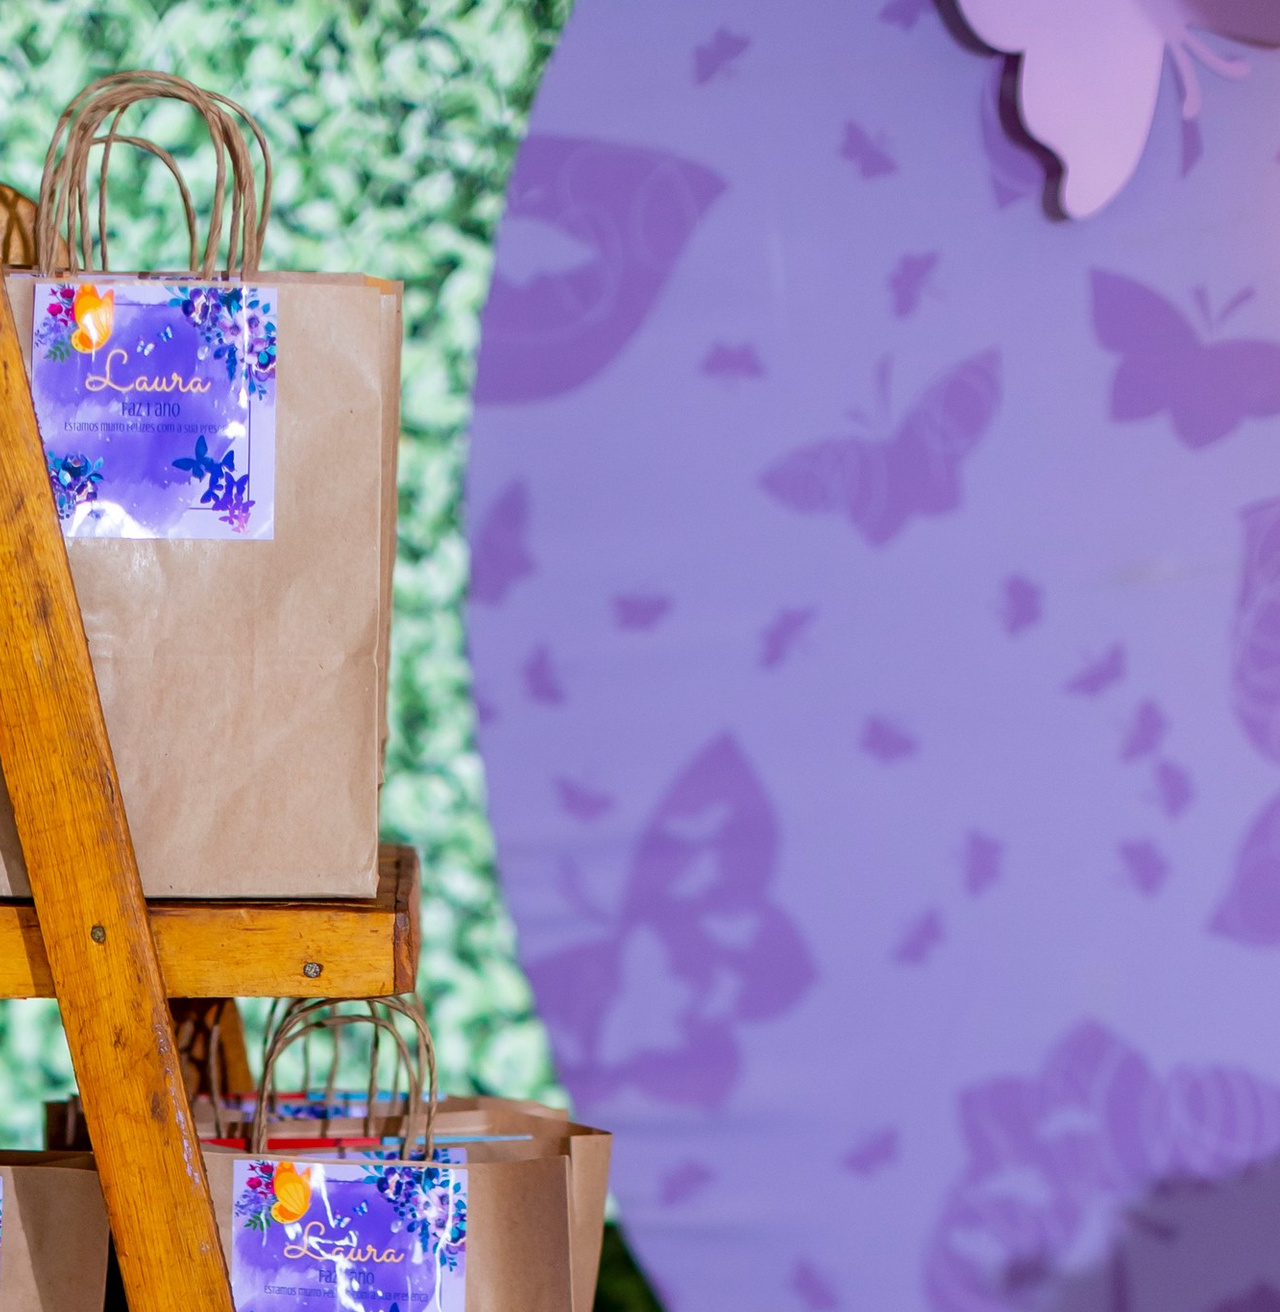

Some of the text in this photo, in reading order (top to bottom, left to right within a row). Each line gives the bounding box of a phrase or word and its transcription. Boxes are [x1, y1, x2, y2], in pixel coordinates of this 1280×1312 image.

[84, 348, 212, 393] Laura
[121, 402, 142, 417] Faz
[154, 401, 181, 418] ano
[64, 421, 99, 432] Estamos
[100, 422, 125, 432] muito
[156, 422, 175, 433] com
[183, 423, 198, 433] sua
[283, 1221, 405, 1263] Laura
[264, 1285, 297, 1296] Estamos
